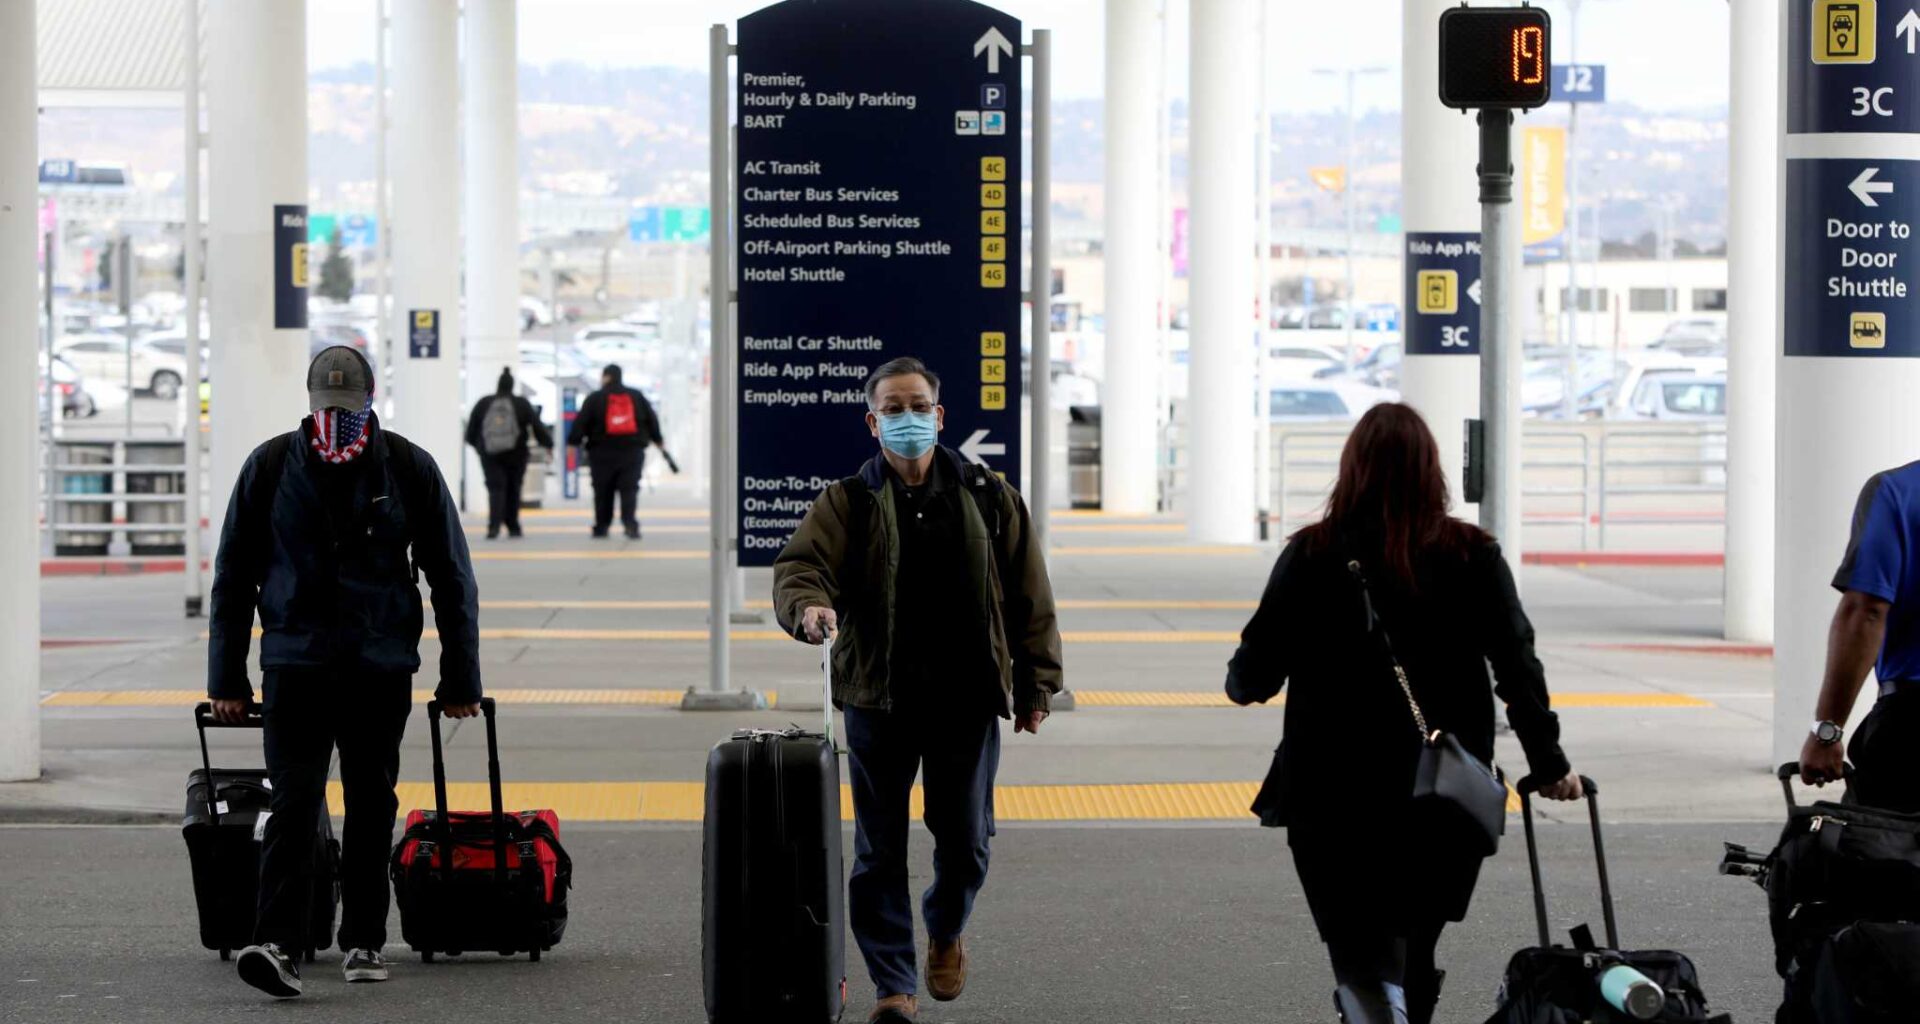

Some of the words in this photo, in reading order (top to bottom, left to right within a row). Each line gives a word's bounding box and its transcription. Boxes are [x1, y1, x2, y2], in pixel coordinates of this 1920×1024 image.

[1513, 26, 1542, 84] 19
[744, 73, 805, 87] Premier,
[1562, 66, 1594, 92] J2
[744, 92, 795, 109] Hourly
[800, 93, 811, 106] &
[816, 92, 854, 109] Daily
[859, 92, 916, 109] Parking
[987, 88, 999, 104] P
[1851, 87, 1894, 117] 3C
[744, 115, 785, 128] BART
[744, 161, 765, 174] AC
[769, 161, 820, 174] Transit
[985, 161, 1001, 176] 4C
[744, 187, 801, 201] Charter
[806, 188, 833, 201] Bus
[838, 188, 899, 201] Services
[985, 189, 1002, 200] 4D
[744, 214, 822, 228] Scheduled
[827, 215, 854, 228] Bus
[859, 214, 920, 228] Services
[986, 216, 1000, 227] 4E
[1828, 219, 1882, 238] Door
[1889, 220, 1910, 239] to
[744, 240, 830, 257] Off-Airport
[834, 241, 891, 258] Parking
[896, 241, 951, 254] Shuttle
[986, 242, 1000, 253] 4F
[1435, 241, 1463, 257] App
[1842, 248, 1897, 268] Door
[744, 267, 785, 281] Hotel
[790, 267, 845, 281] Shuttle
[985, 269, 1002, 283] 4G
[1829, 276, 1907, 298] Shuttle
[744, 336, 792, 350] Rental
[797, 336, 823, 350] Car
[827, 336, 882, 350] Shuttle
[985, 338, 1002, 349] 3D
[1441, 326, 1469, 347] 3C
[744, 362, 777, 376] Ride
[782, 363, 814, 380] App
[819, 362, 868, 381] Pickup
[986, 365, 1001, 376] 3C
[744, 389, 818, 406] Employee
[986, 391, 1001, 403] 3B
